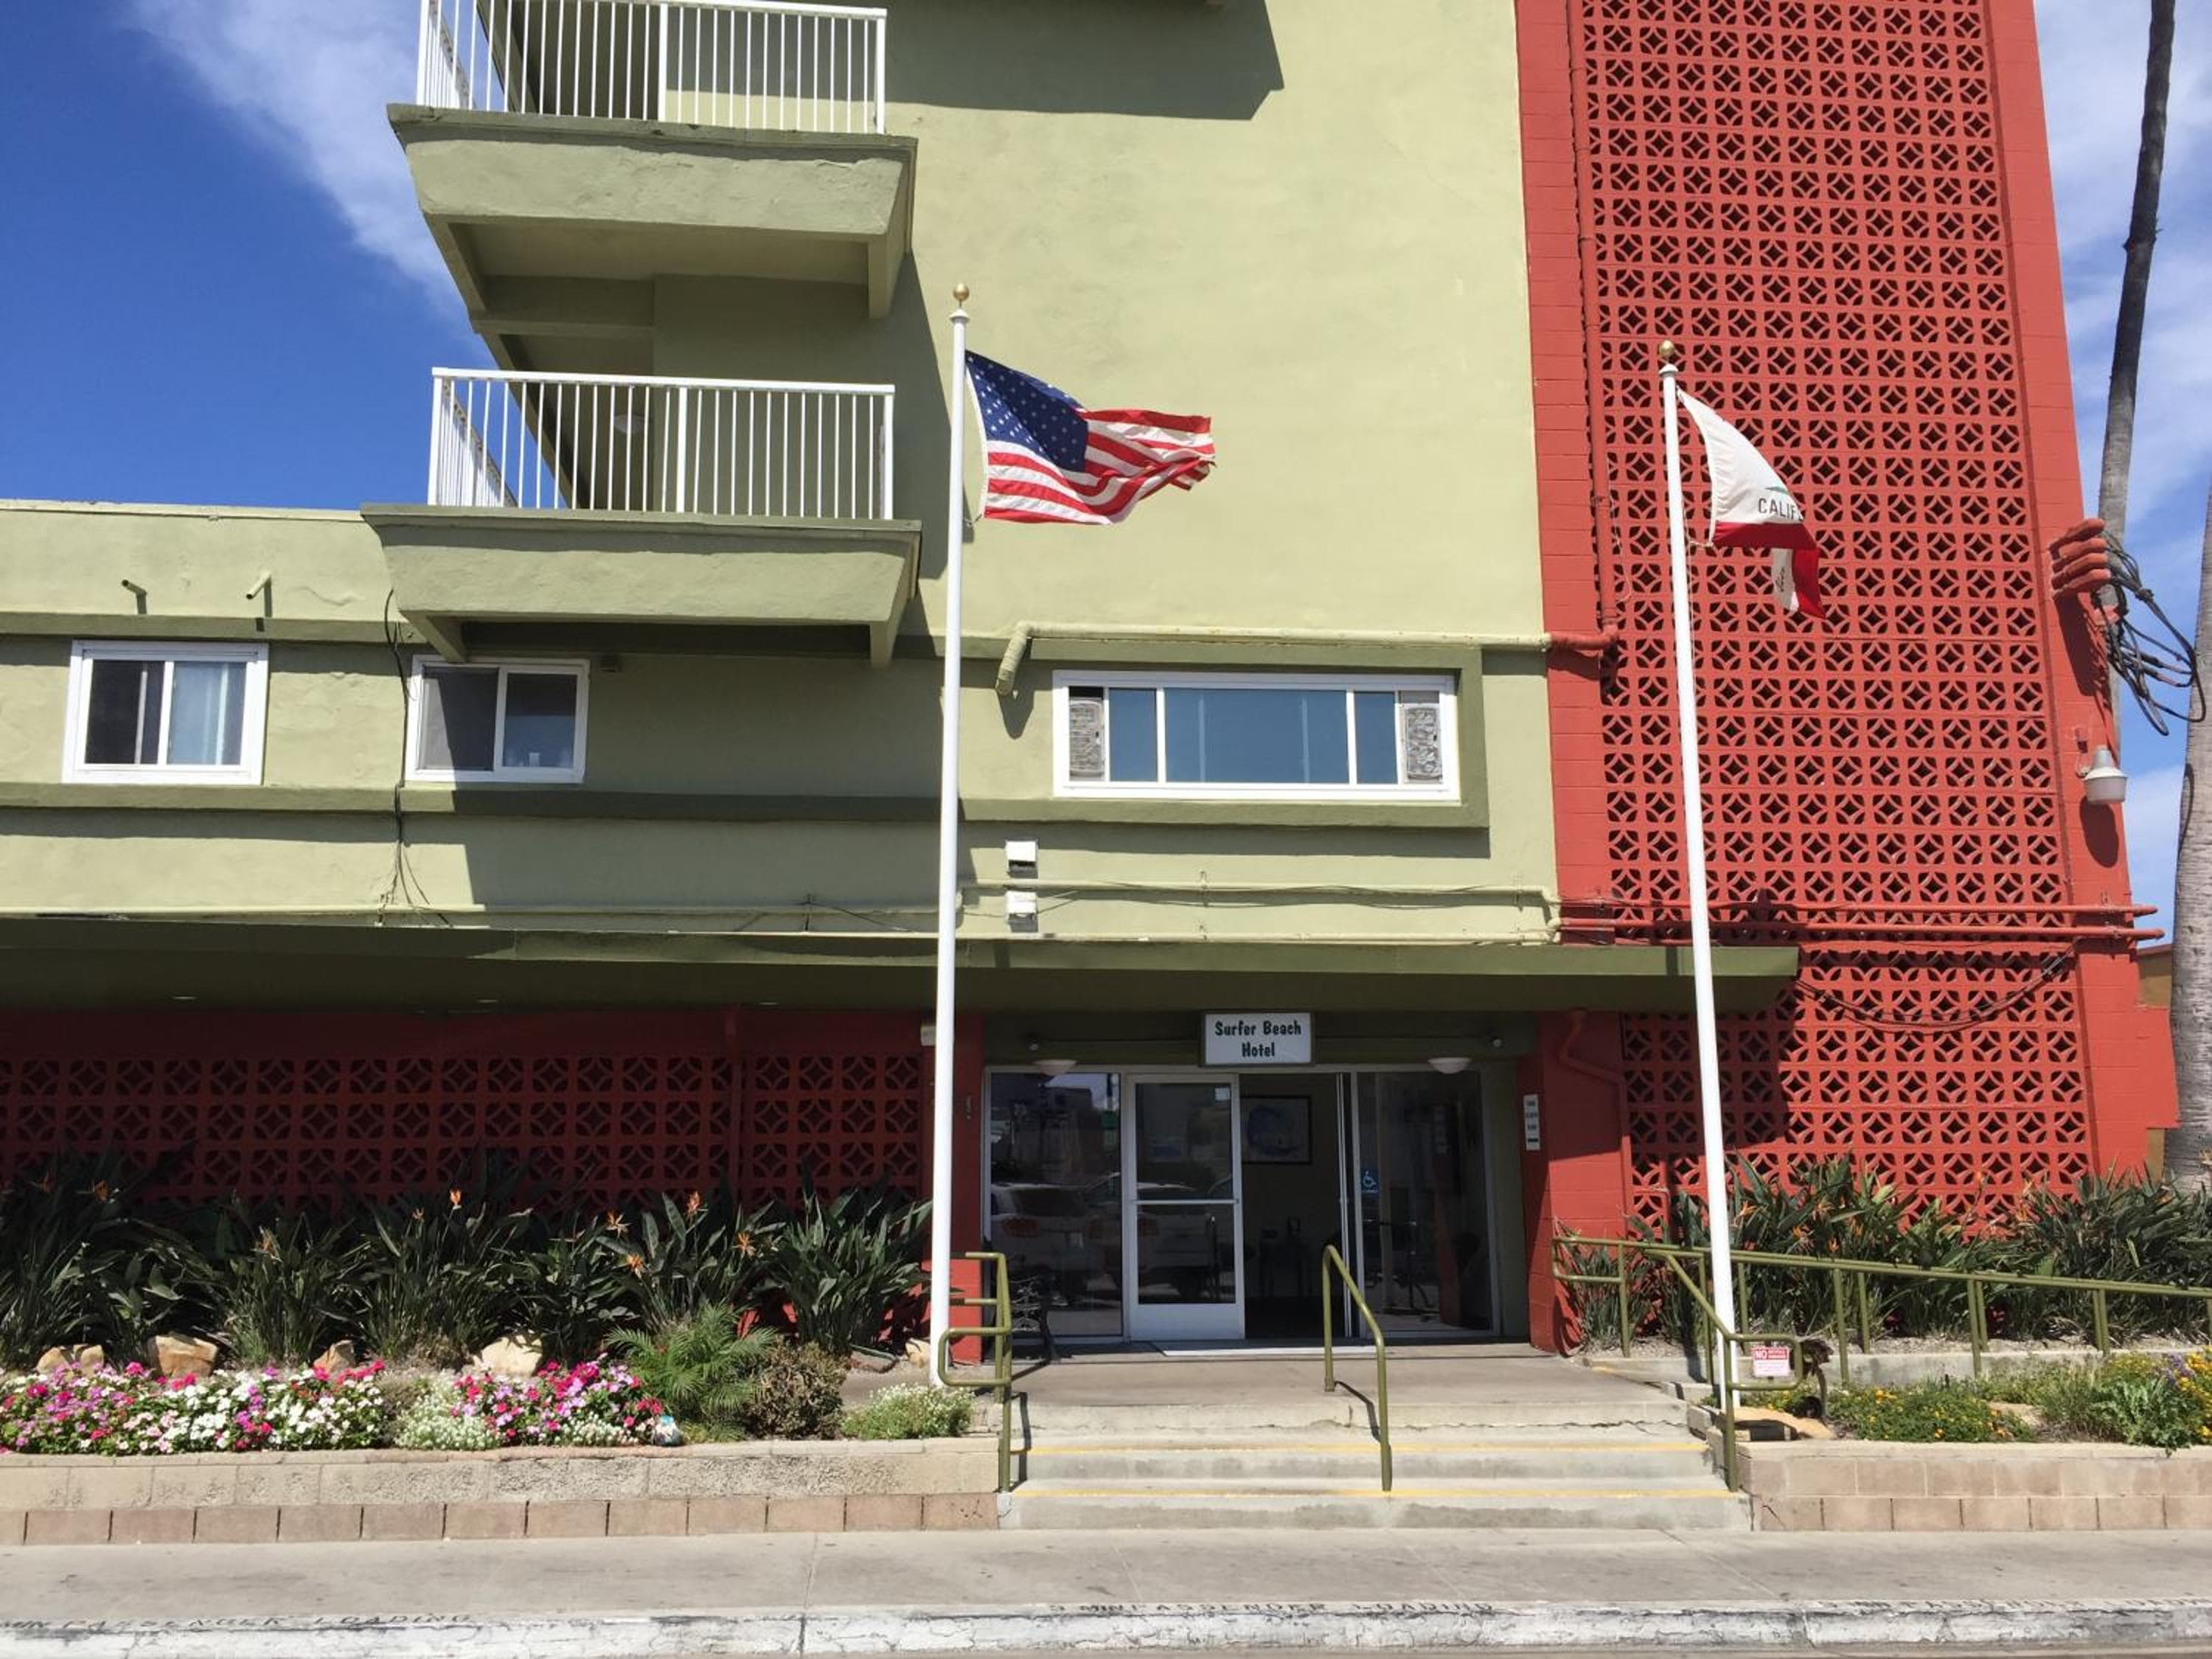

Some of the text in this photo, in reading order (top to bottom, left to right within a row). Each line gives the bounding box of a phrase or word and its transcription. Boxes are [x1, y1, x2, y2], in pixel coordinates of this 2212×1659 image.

[1759, 498, 1802, 521] CALIF
[1215, 1020, 1302, 1036] Surfer Beach
[1242, 1042, 1276, 1057] Hotel
